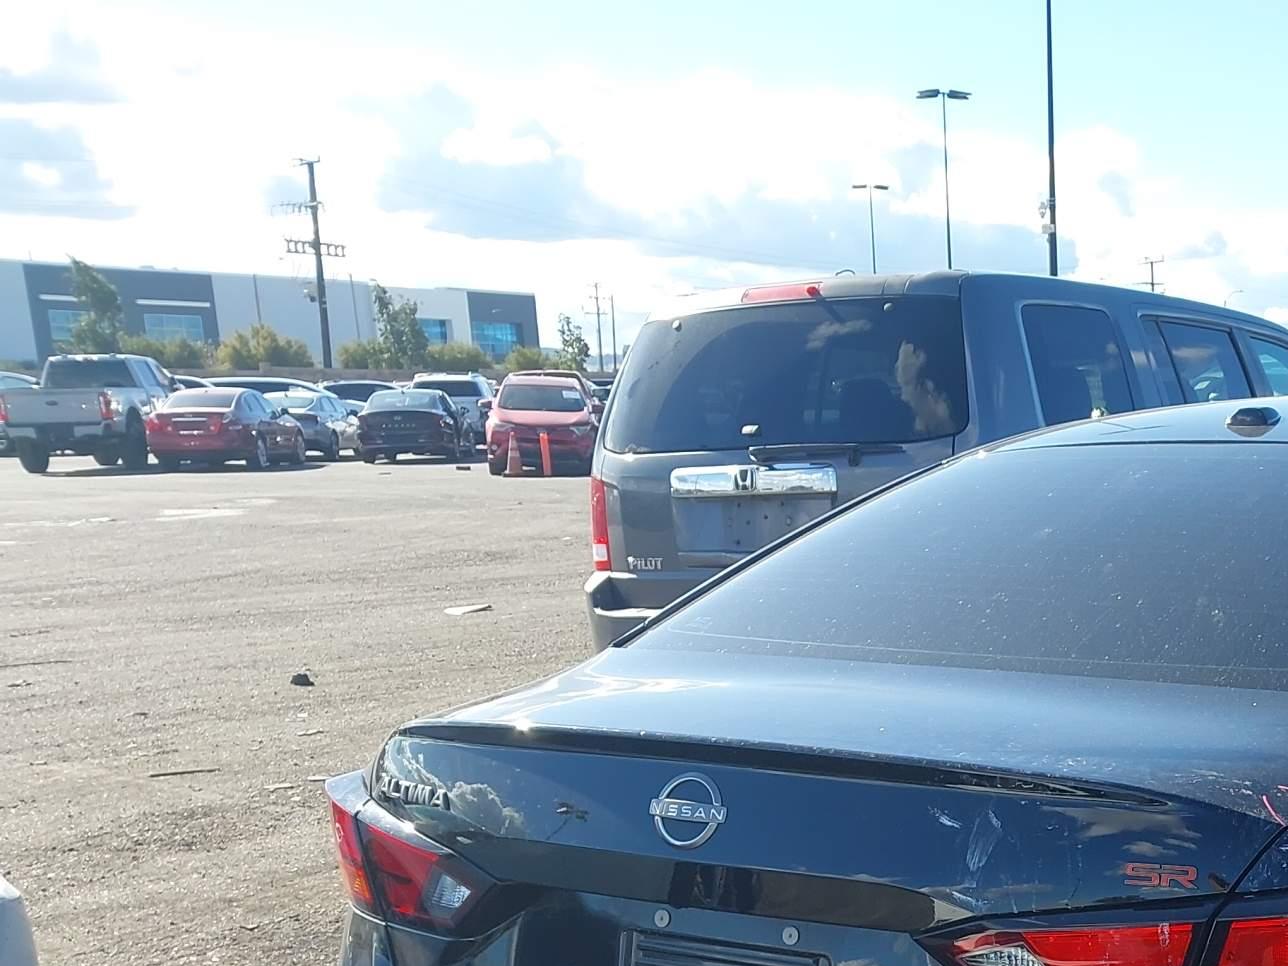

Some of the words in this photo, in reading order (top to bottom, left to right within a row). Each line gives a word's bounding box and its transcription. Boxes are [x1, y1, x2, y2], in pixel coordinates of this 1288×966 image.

[627, 556, 663, 570] PILOT
[376, 776, 449, 811] ALTIMA
[651, 801, 724, 820] NISSAN
[1124, 862, 1198, 889] SR
